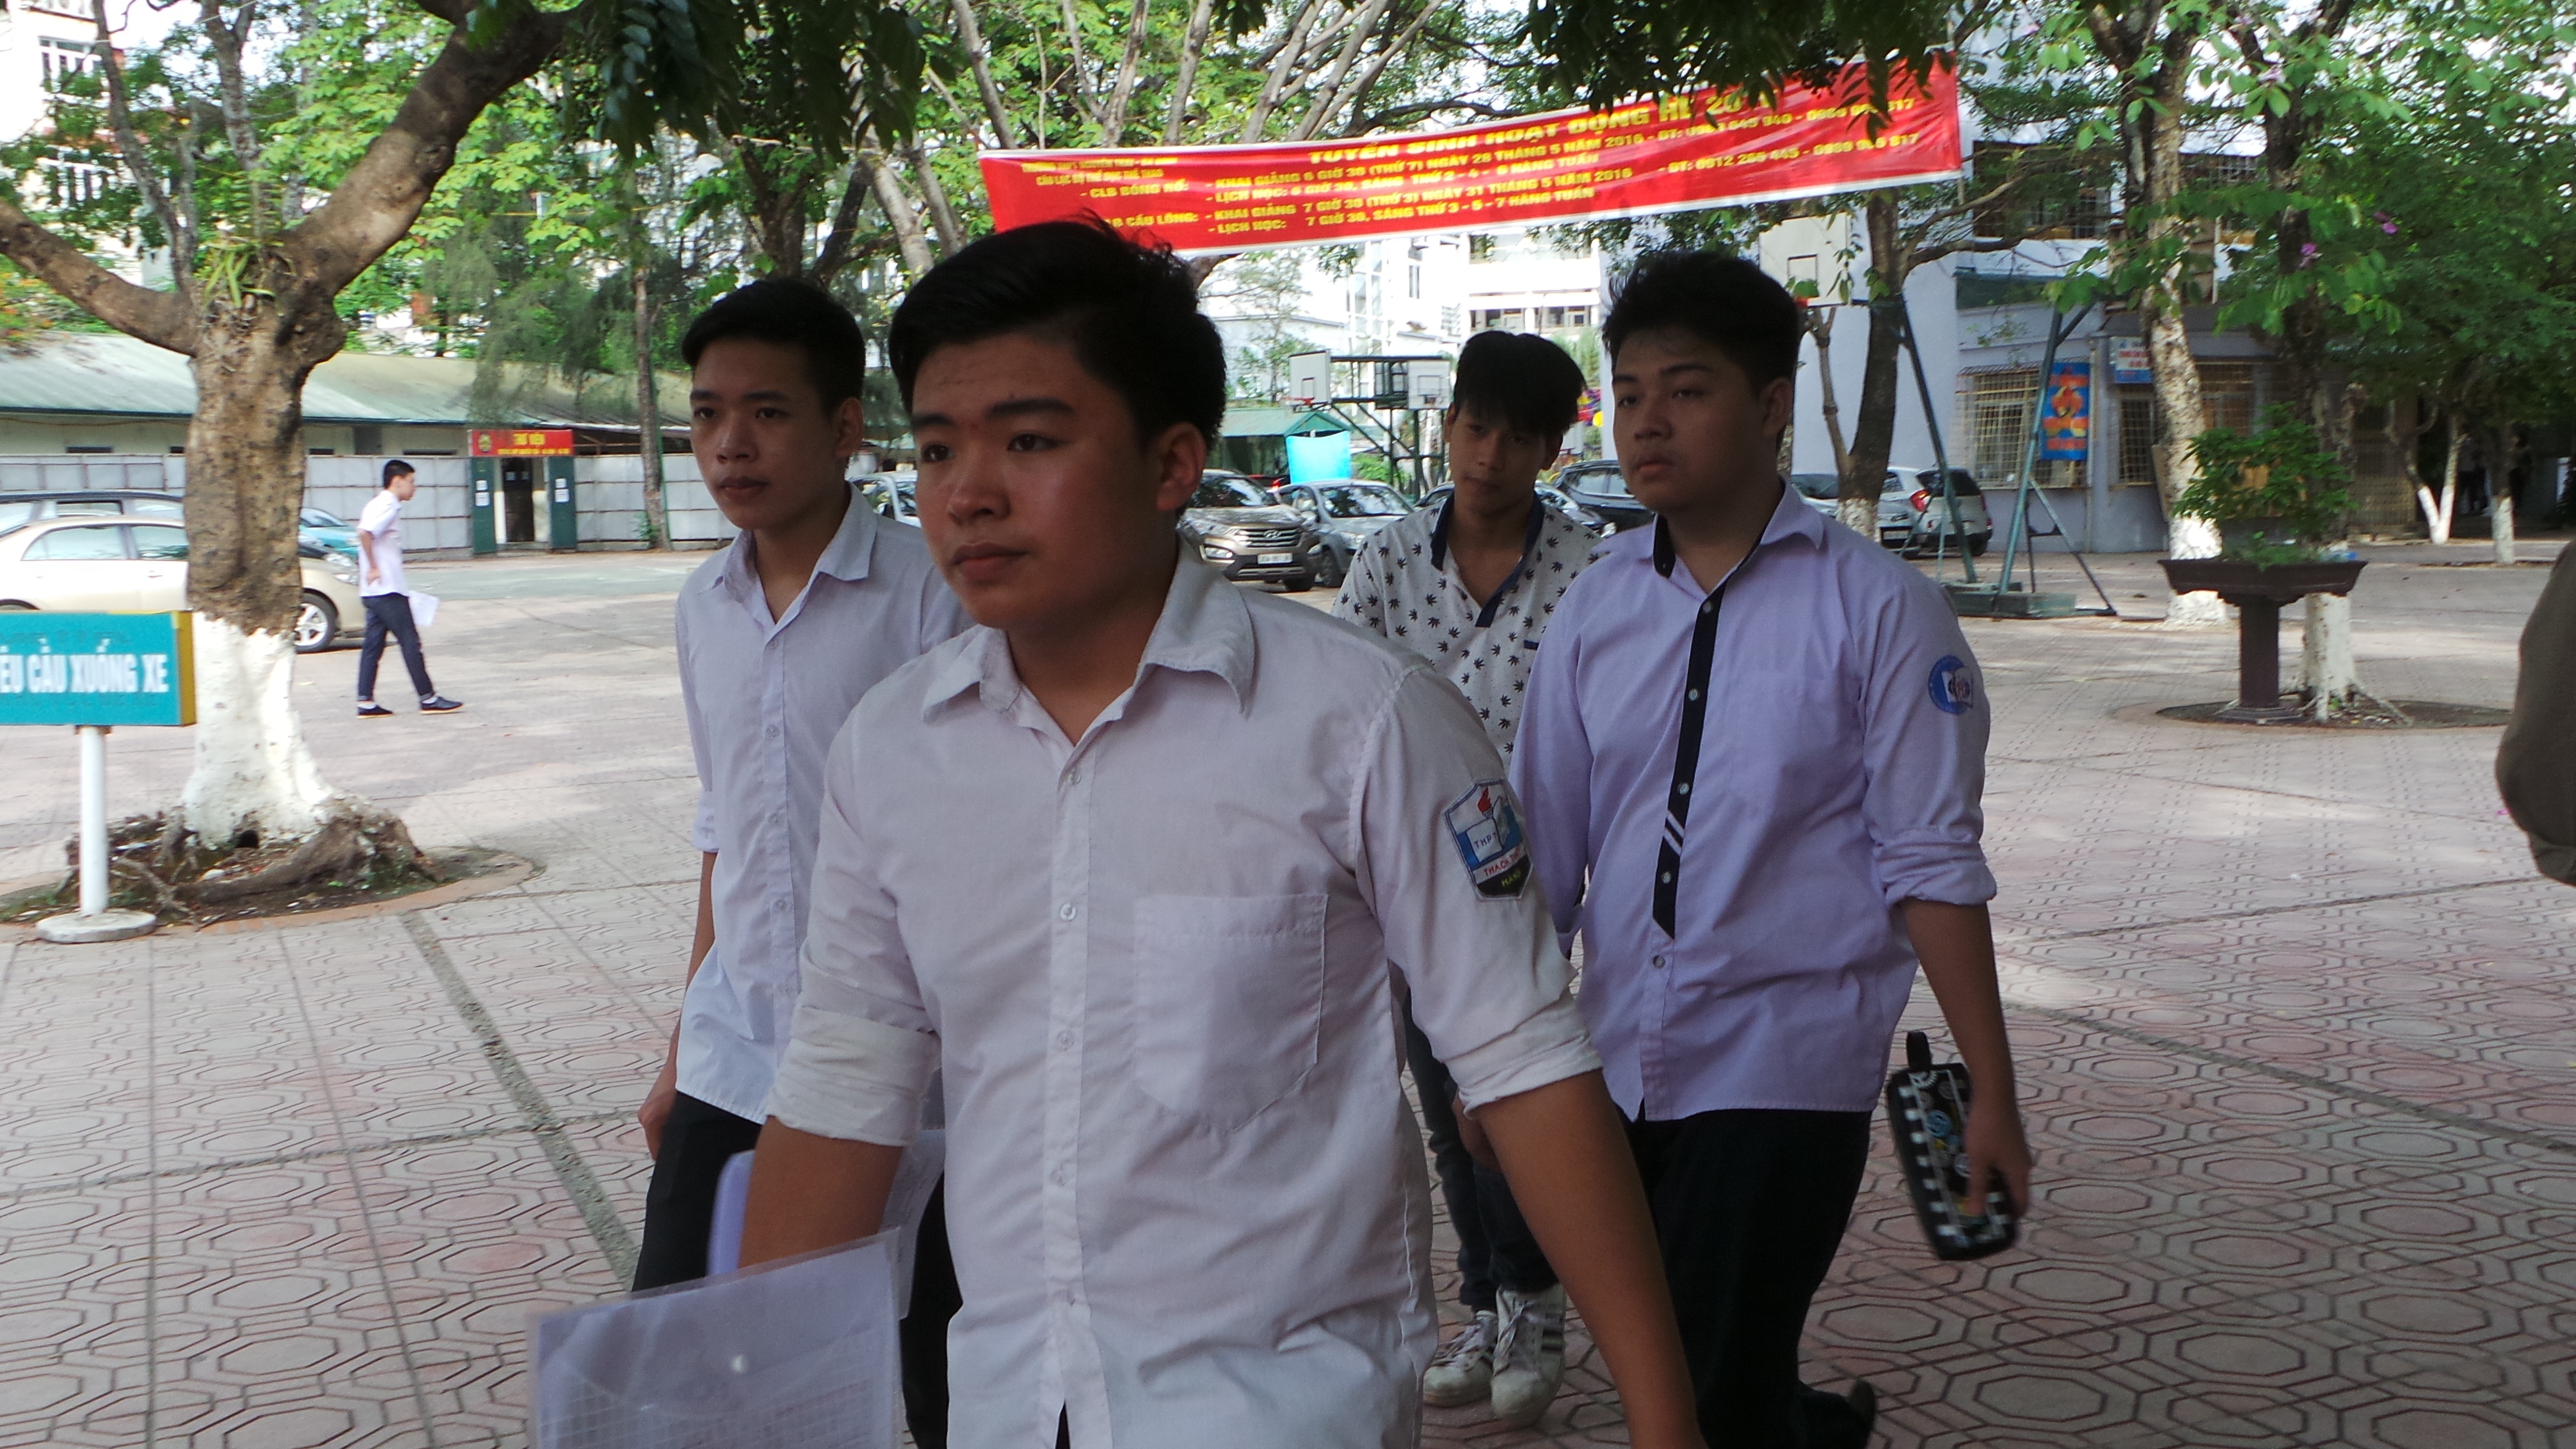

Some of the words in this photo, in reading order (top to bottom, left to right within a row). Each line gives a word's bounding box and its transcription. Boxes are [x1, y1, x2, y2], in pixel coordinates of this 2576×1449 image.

[1215, 177, 1252, 188] KHAI
[1254, 171, 1301, 186] GIẢNG
[1317, 167, 1343, 180] GIỜ
[1346, 167, 1366, 176] 30
[1369, 160, 1405, 175] (THỨ
[1407, 160, 1423, 171] 7)
[1426, 155, 1469, 169] NGÀY
[1472, 153, 1491, 164] 28
[1494, 146, 1546, 161] THÁNG
[1550, 144, 1561, 155] 5
[1564, 138, 1602, 153] NĂM
[1605, 134, 1645, 148] 2016
[1309, 141, 1398, 164] TUYỂN
[1406, 134, 1478, 154] SINH
[1485, 123, 1560, 144] HOẠT
[1568, 107, 1650, 135] ĐỘNG
[1090, 187, 1117, 198] CLB
[1120, 184, 1160, 196] BÓNG
[1214, 209, 1249, 220] KHAI
[1251, 203, 1296, 217] GIẢNG
[1303, 203, 1313, 213] 7
[1317, 198, 1342, 211] GIỜ
[1344, 197, 1364, 209] 30
[1366, 193, 1402, 207] (THỨ
[1403, 192, 1419, 203] 3)
[1422, 187, 1464, 201] NGÀY
[1466, 185, 1484, 196] 31
[1488, 178, 1538, 193] THÁNG
[1541, 177, 1552, 188] 5
[1555, 172, 1592, 187] NĂM
[1594, 168, 1633, 182] 2016
[1215, 191, 1249, 203] LỊCH
[1252, 187, 1288, 200] HỌC:
[1304, 182, 1332, 193] GIỜ
[1361, 175, 1404, 190] SÁNG
[1411, 170, 1442, 184] THỨ
[1443, 171, 1455, 181] 2
[1468, 169, 1479, 178] 4
[1511, 158, 1554, 173] HÀNG
[1556, 152, 1599, 167] TUẦN
[1125, 214, 1154, 226] CẦU
[1157, 212, 1199, 224] LÔNG:
[1217, 222, 1251, 234] LỊCH
[1252, 219, 1287, 231] HỌC:
[1305, 216, 1315, 226] 7
[1319, 212, 1344, 225] GIỜ
[1372, 205, 1414, 220] SÁNG
[1416, 202, 1447, 216] THỨ
[1448, 202, 1460, 213] 3
[1471, 200, 1483, 211] 5
[1495, 197, 1506, 208] 7
[1509, 192, 1551, 206] HÀNG
[1554, 186, 1595, 201] TUẦN
[28, 637, 68, 693] CẦU
[69, 637, 139, 693] XUỐNG
[141, 654, 169, 693] XE
[1474, 832, 1497, 849] THPT
